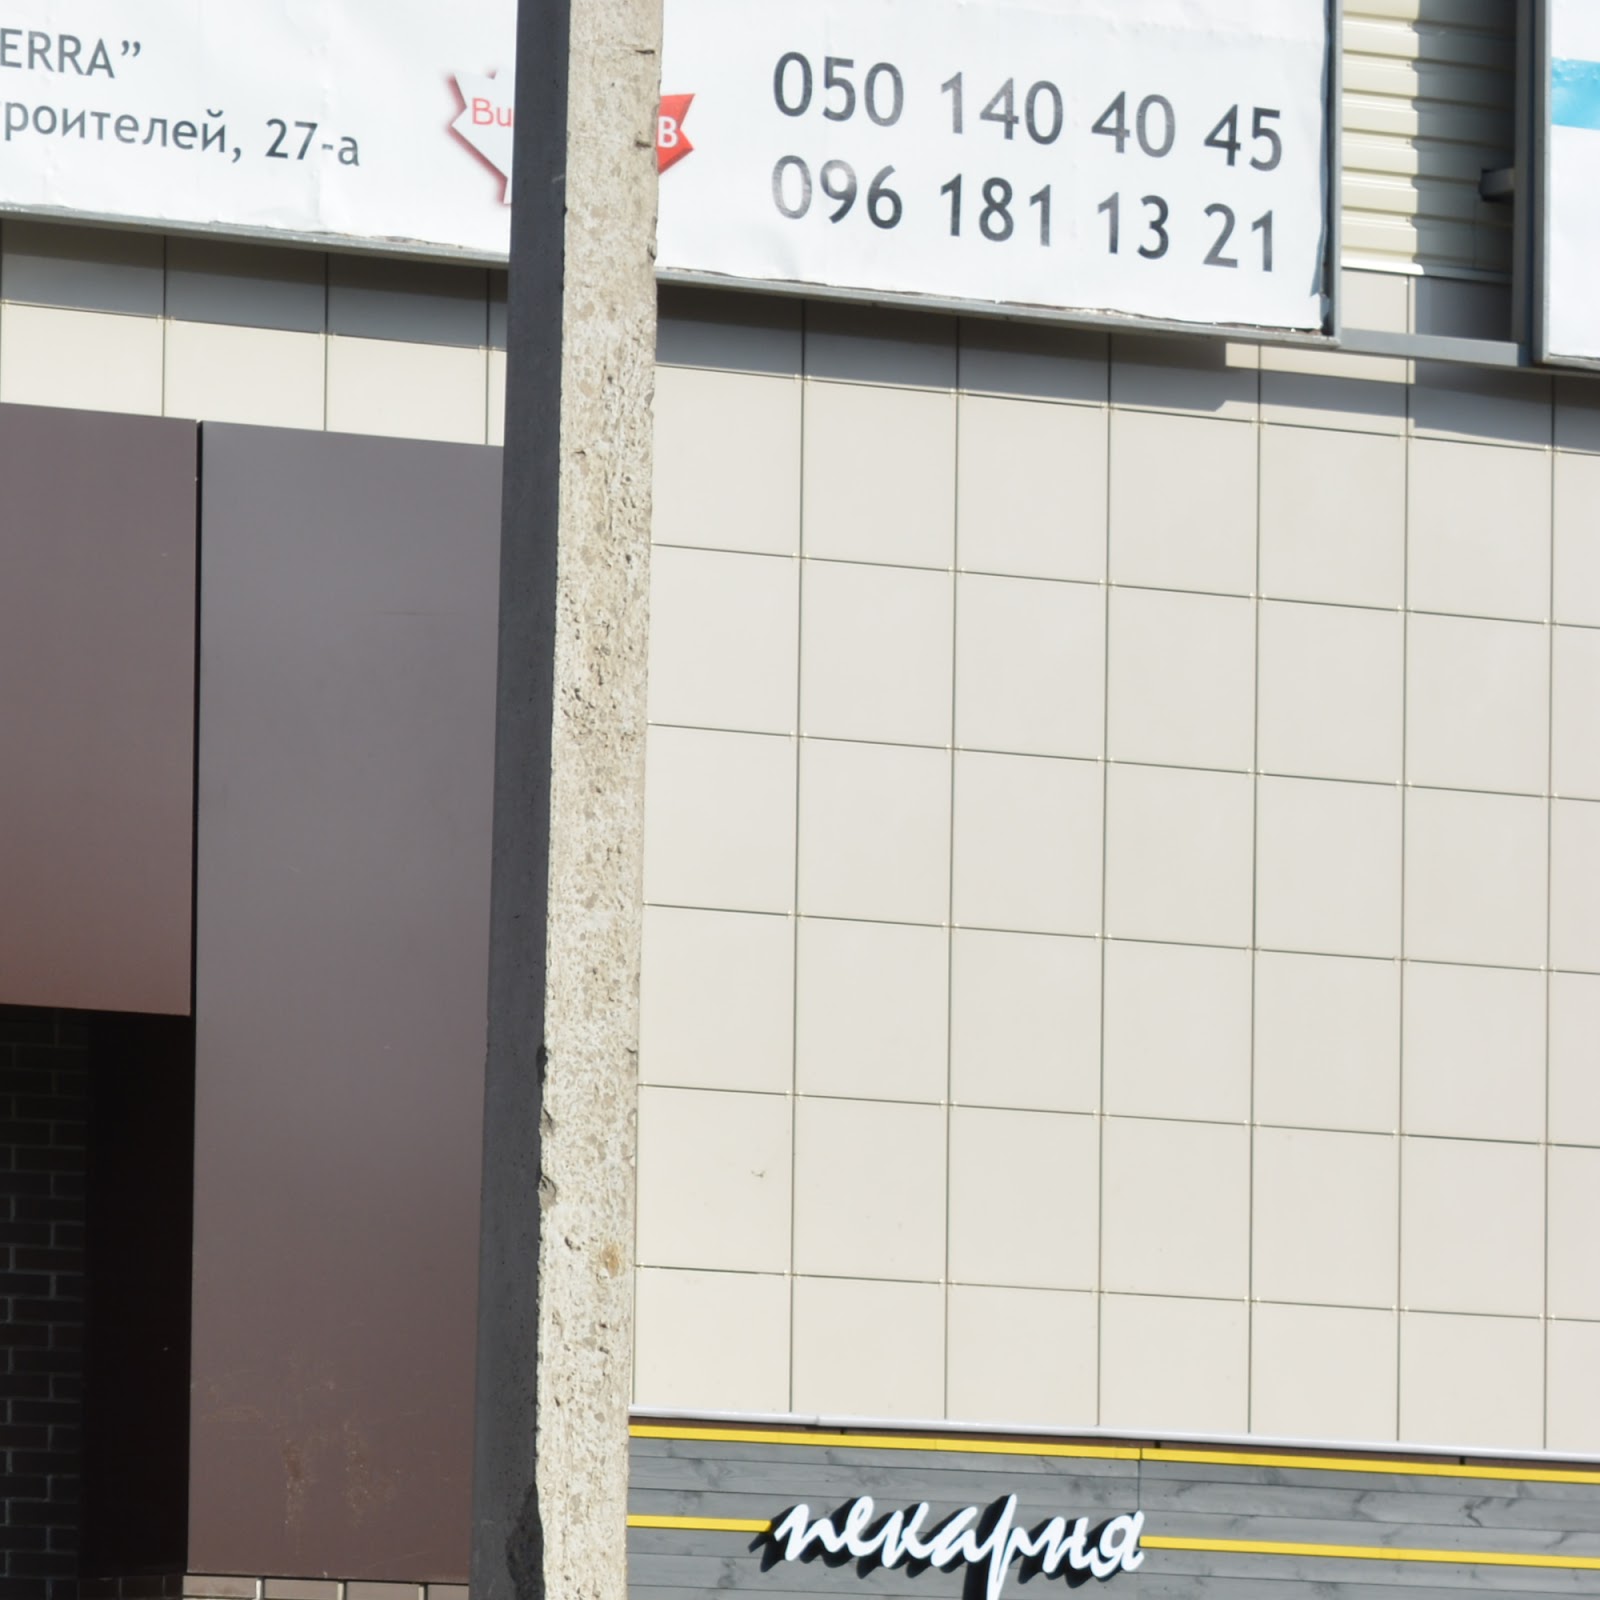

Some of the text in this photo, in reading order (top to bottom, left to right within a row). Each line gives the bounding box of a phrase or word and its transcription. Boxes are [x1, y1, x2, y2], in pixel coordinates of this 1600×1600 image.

[264, 117, 361, 168] 27-а
[772, 51, 1283, 172] 050 140 40 45
[770, 154, 1273, 273] 096 181 13 21
